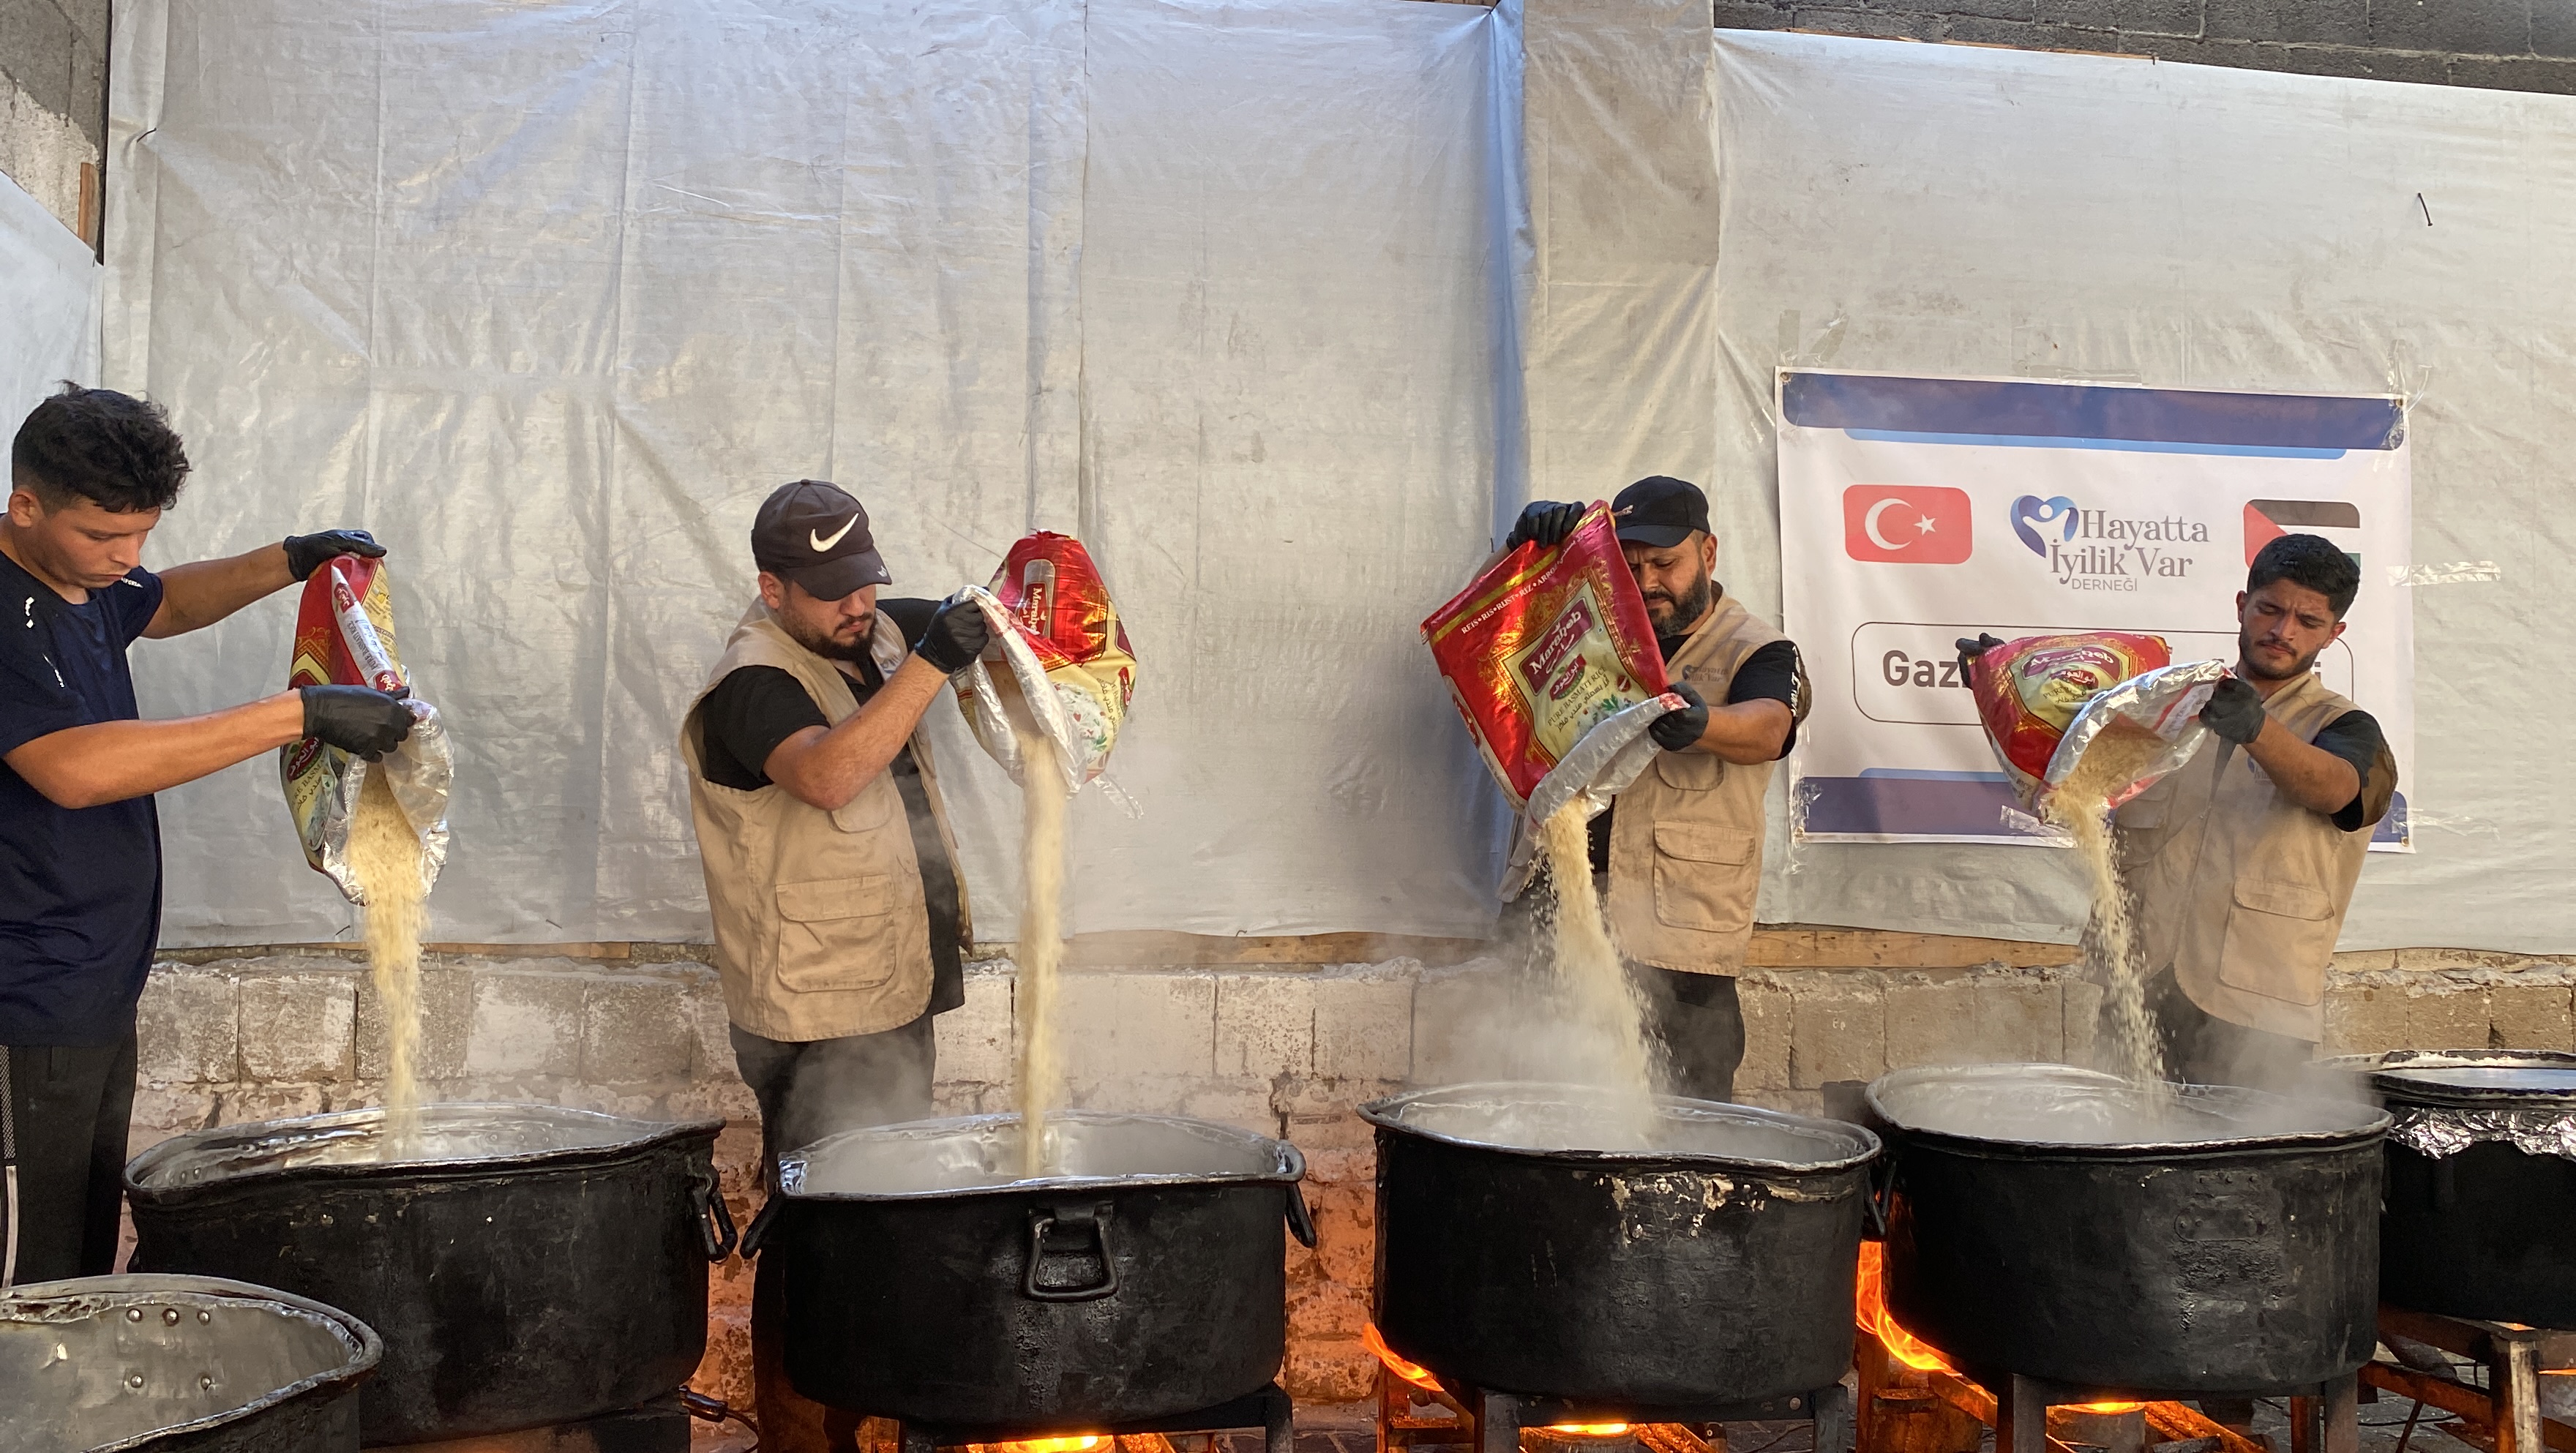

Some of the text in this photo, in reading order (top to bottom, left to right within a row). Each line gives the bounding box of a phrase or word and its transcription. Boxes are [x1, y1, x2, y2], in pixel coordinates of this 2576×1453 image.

[2081, 509, 2211, 551] Hayatta
[2050, 538, 2193, 585] İyilik Var
[2072, 577, 2138, 591] DERNEĞİ
[1028, 587, 1043, 631] Marahe
[1461, 617, 1480, 634] REIS
[1480, 608, 1494, 621] RIS
[1519, 584, 1534, 597] RIZ
[1883, 650, 1969, 688] Gaz
[1548, 707, 1565, 726] PURE
[1563, 680, 1592, 710] BASMATI
[302, 760, 323, 788] BASMA
